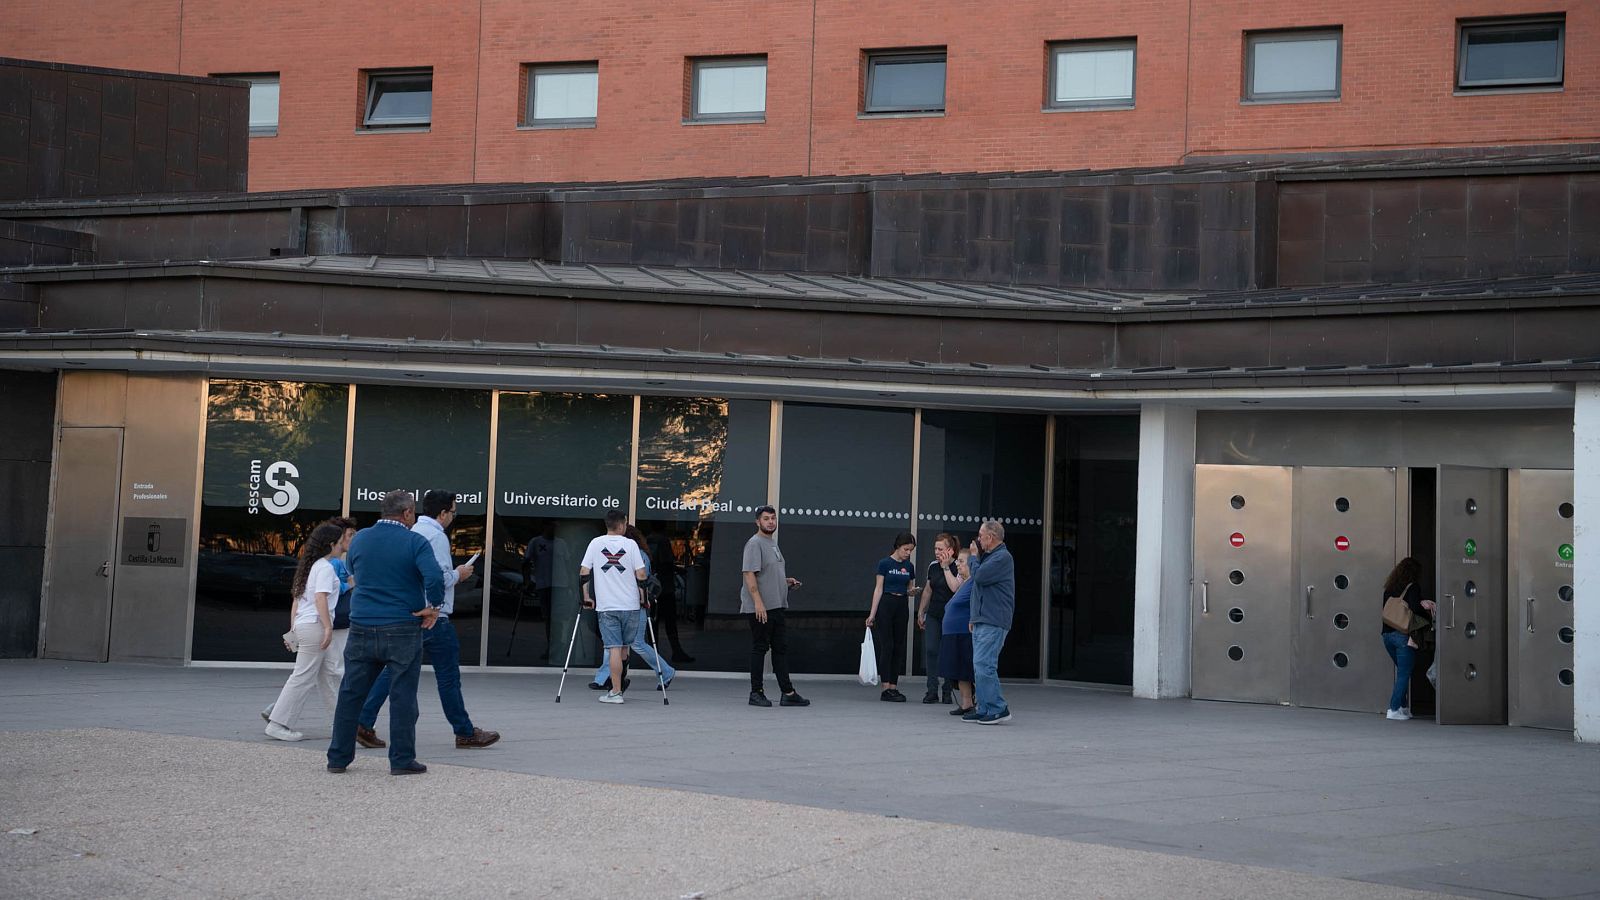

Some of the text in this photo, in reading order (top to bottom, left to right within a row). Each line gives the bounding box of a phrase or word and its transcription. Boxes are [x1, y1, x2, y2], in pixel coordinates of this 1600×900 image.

[133, 482, 154, 490] Entrada
[248, 459, 262, 515] sescam
[357, 488, 733, 512] Hosl eral Universitario de Ciudad Real
